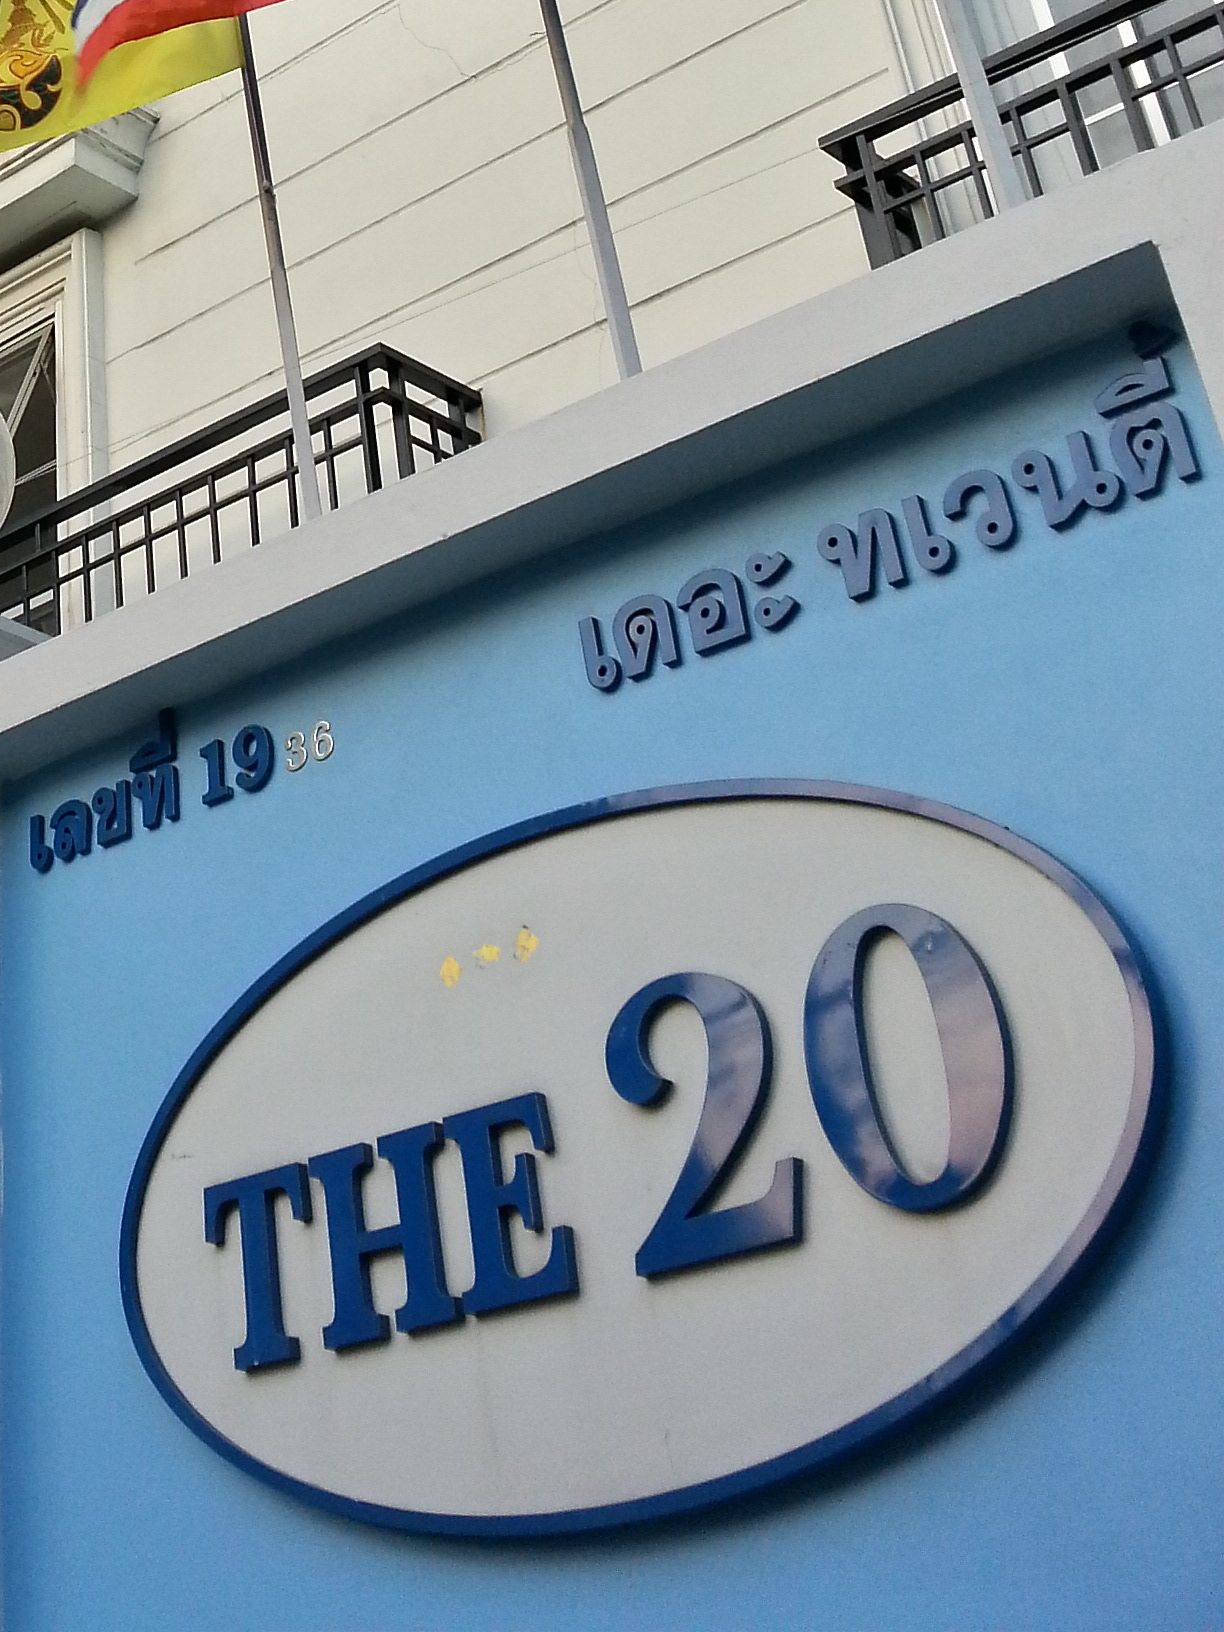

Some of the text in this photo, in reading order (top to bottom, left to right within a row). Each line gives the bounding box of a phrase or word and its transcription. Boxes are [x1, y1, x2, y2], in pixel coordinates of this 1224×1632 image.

[577, 549, 801, 693] เดอะ
[29, 706, 181, 874] เลขที่
[202, 902, 1017, 1373] THE 20
